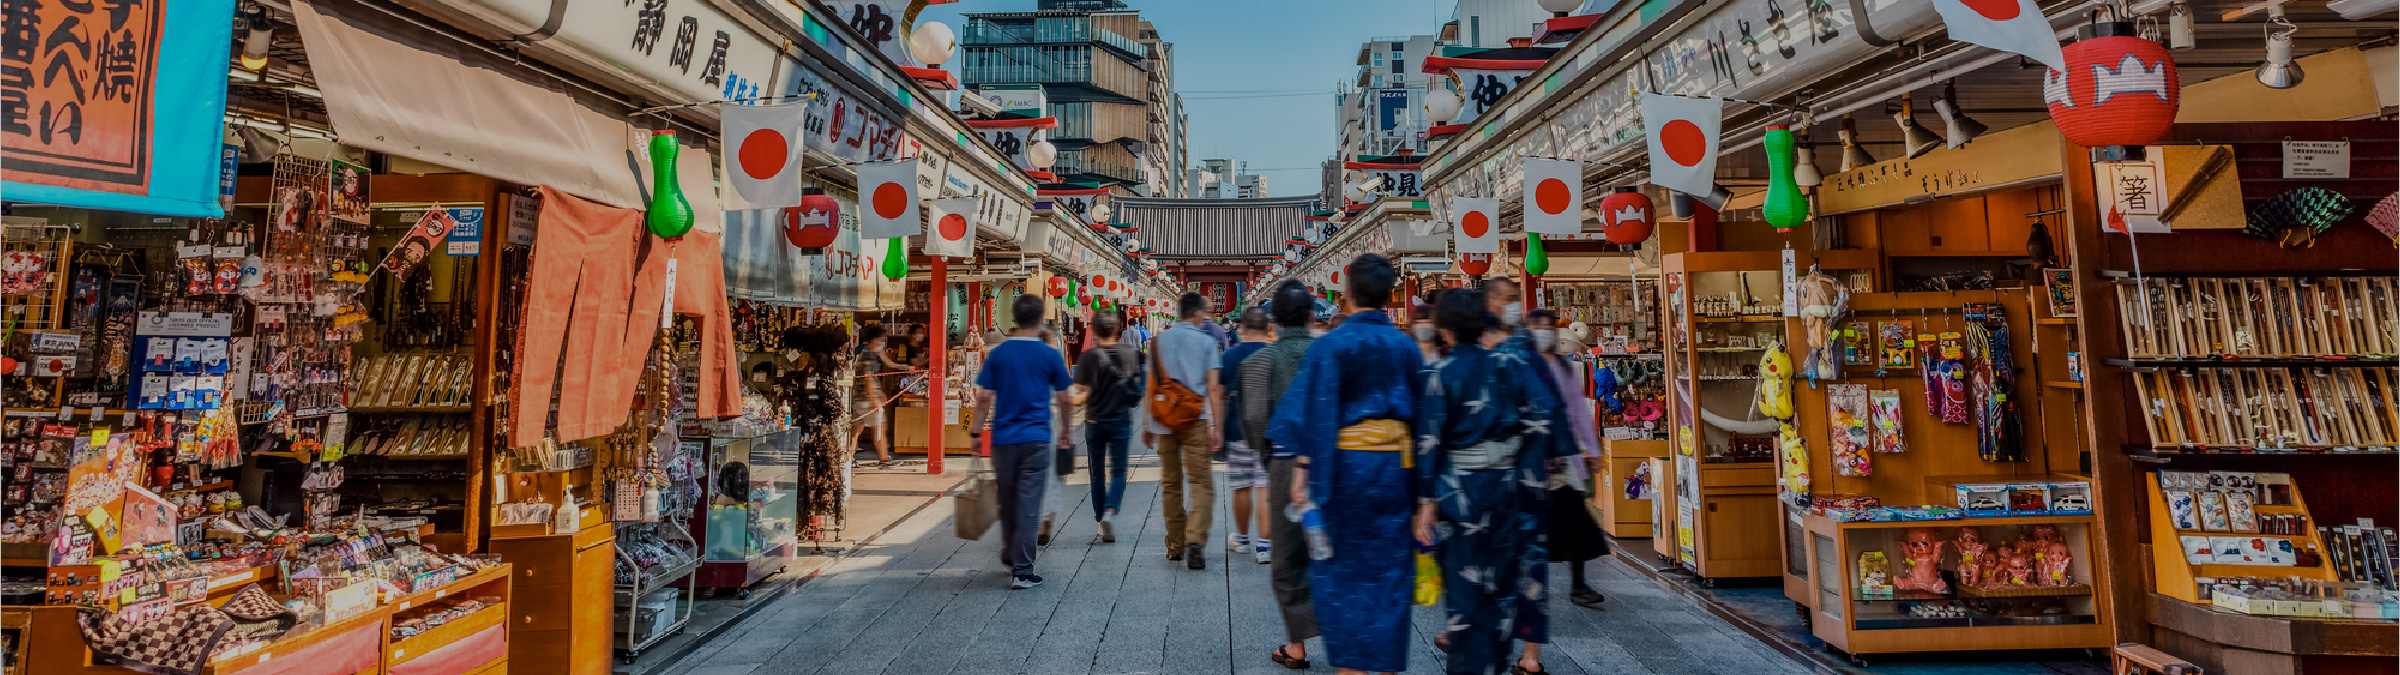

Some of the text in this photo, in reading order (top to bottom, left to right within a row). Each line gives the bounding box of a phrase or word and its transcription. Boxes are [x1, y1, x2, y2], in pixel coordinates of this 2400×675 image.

[40, 0, 94, 145] んべい
[1471, 75, 1527, 114] 仲
[1376, 172, 1425, 197] 仲見
[2119, 174, 2152, 210] 箸
